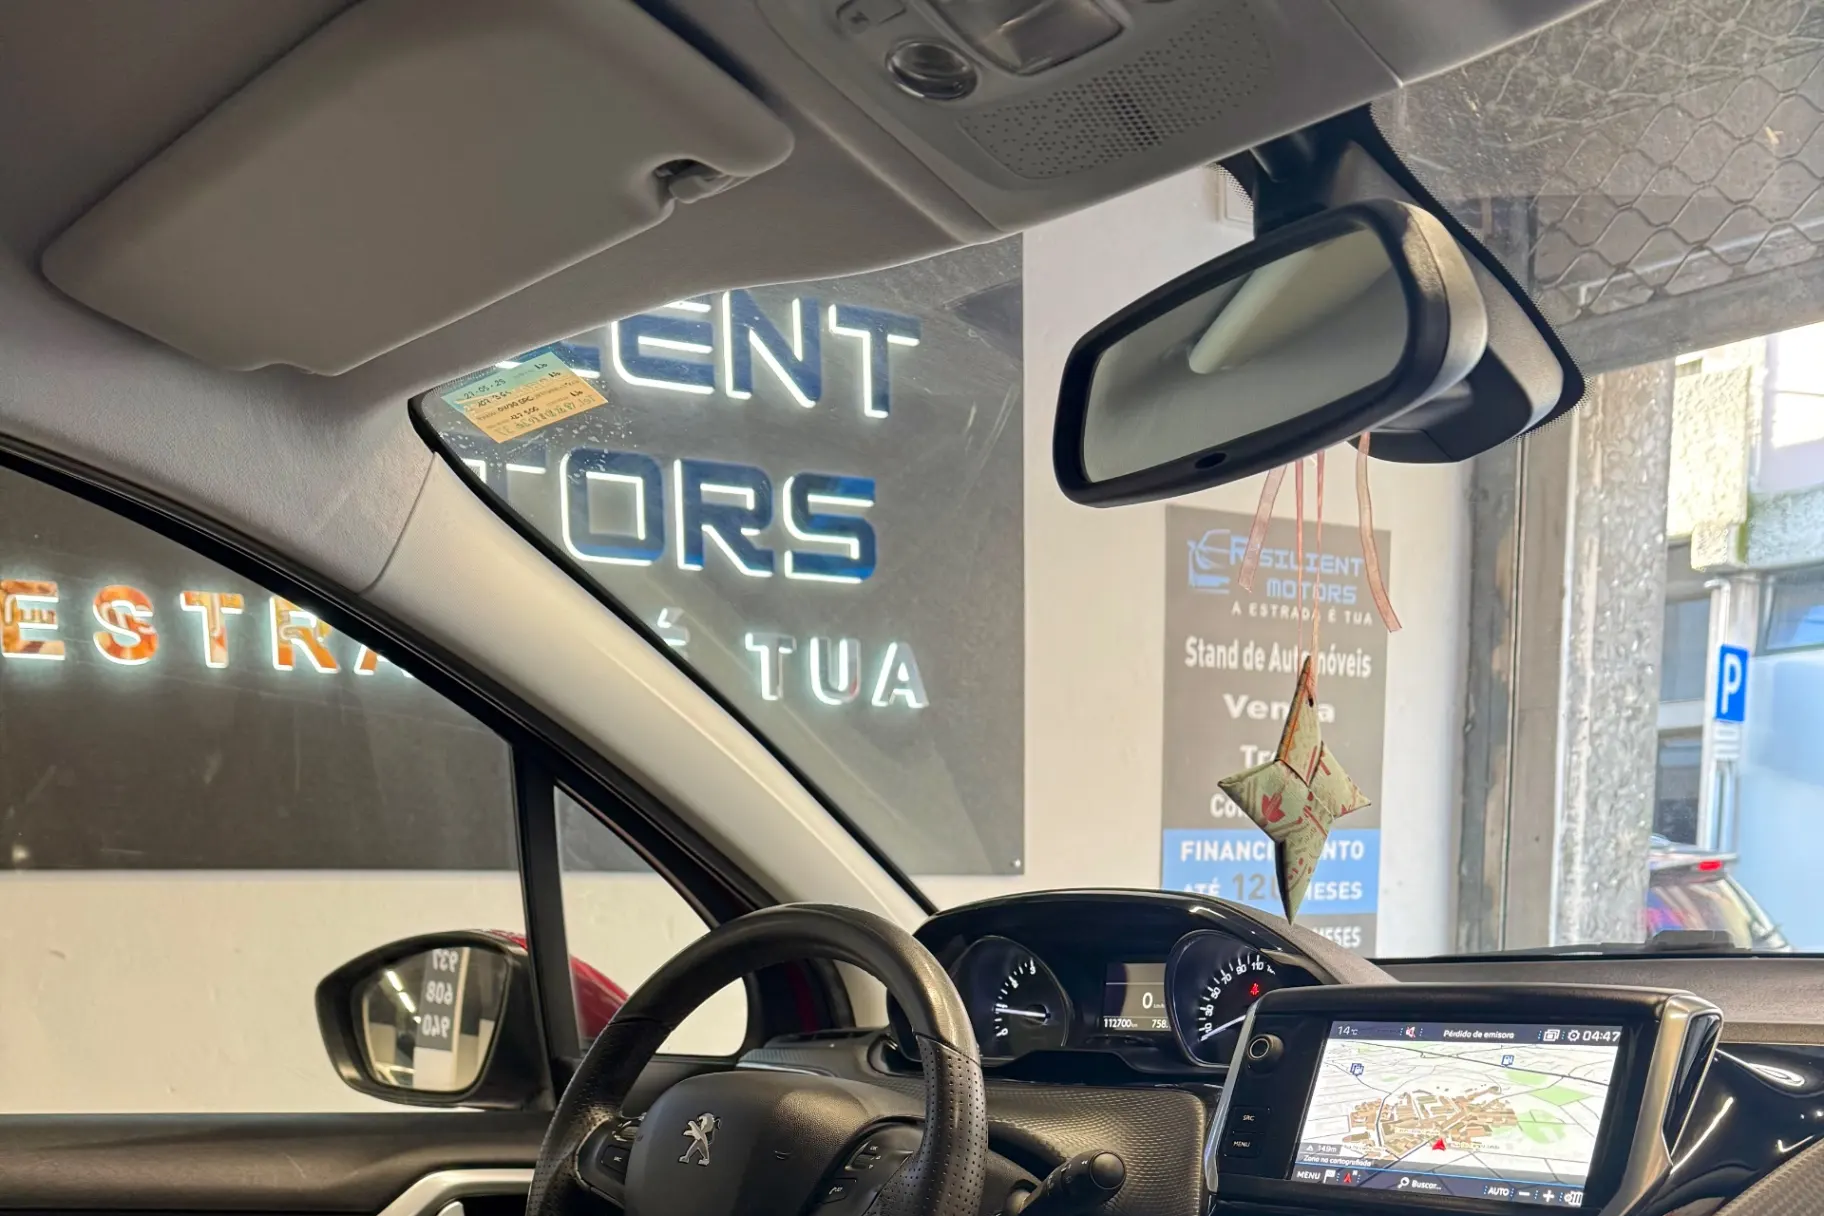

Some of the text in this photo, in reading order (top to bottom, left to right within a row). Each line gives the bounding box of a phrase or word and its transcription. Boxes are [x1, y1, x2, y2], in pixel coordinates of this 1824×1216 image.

[494, 289, 922, 419] ENT
[1230, 535, 1364, 577] RSILIENT
[1266, 577, 1357, 605] MOTORS
[1231, 601, 1242, 616] A
[1328, 606, 1337, 624] É
[1344, 610, 1373, 627] TUA
[1184, 636, 1240, 670] Stand
[1243, 640, 1266, 671] de
[745, 631, 929, 708] TUA
[1721, 652, 1742, 714] P
[1222, 693, 1336, 723] Vena
[1180, 840, 1364, 861] FINANCINTO
[1142, 992, 1153, 1009] 0
[1205, 1004, 1214, 1017] 30
[1104, 1018, 1132, 1028] 112700
[1472, 1030, 1483, 1038] de
[1483, 1031, 1515, 1039] emisora
[1582, 1030, 1621, 1042] 04:47
[1296, 1170, 1321, 1180] MENU
[1488, 1187, 1510, 1197] AUTO
